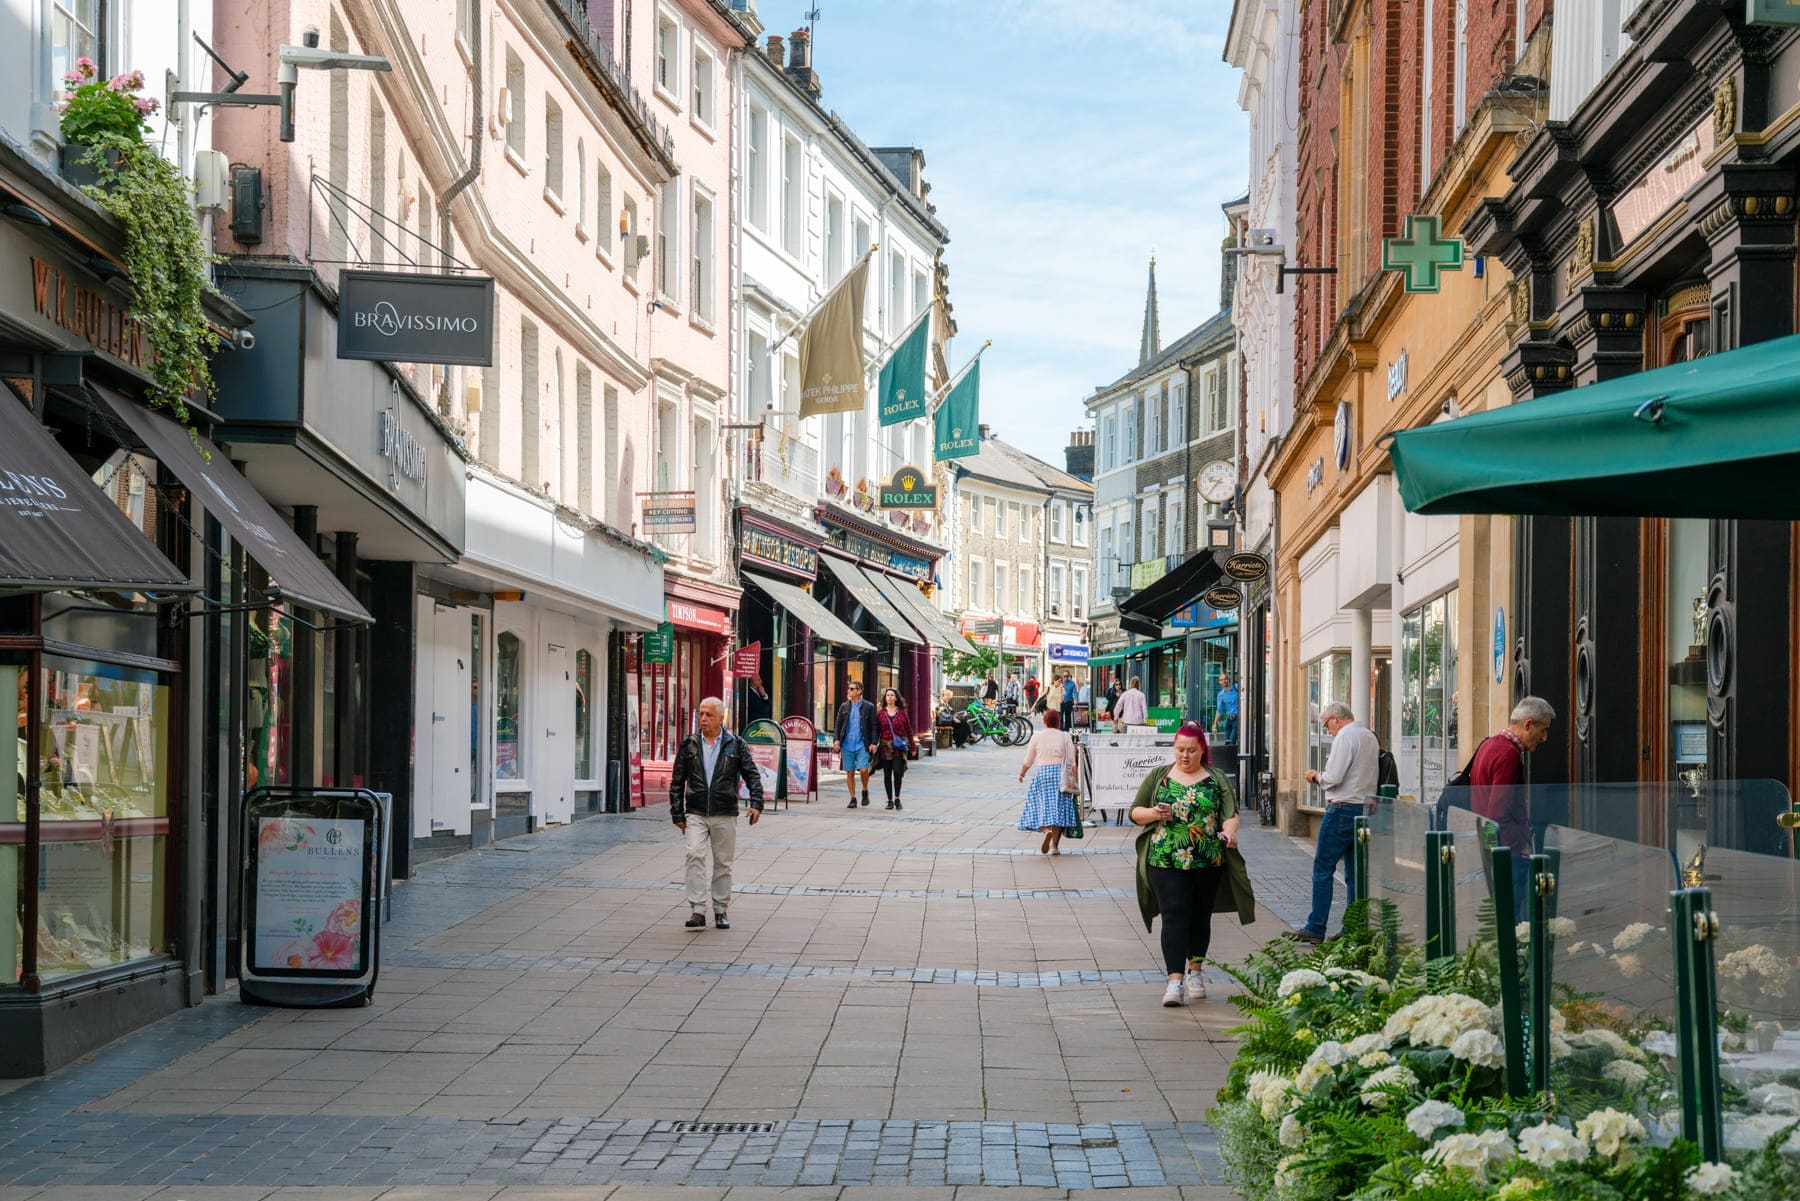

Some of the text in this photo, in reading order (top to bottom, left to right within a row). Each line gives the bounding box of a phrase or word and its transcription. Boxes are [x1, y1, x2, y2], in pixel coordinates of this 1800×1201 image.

[354, 301, 478, 336] BRAVISSIMO
[822, 383, 860, 394] PHILIPPE
[883, 399, 920, 416] ROLEX
[939, 438, 974, 451] ROLEX
[883, 492, 933, 505] ROLEX
[782, 541, 810, 571] BISHOP
[671, 603, 697, 623] TIMPSON
[307, 847, 360, 856] BULLENS
